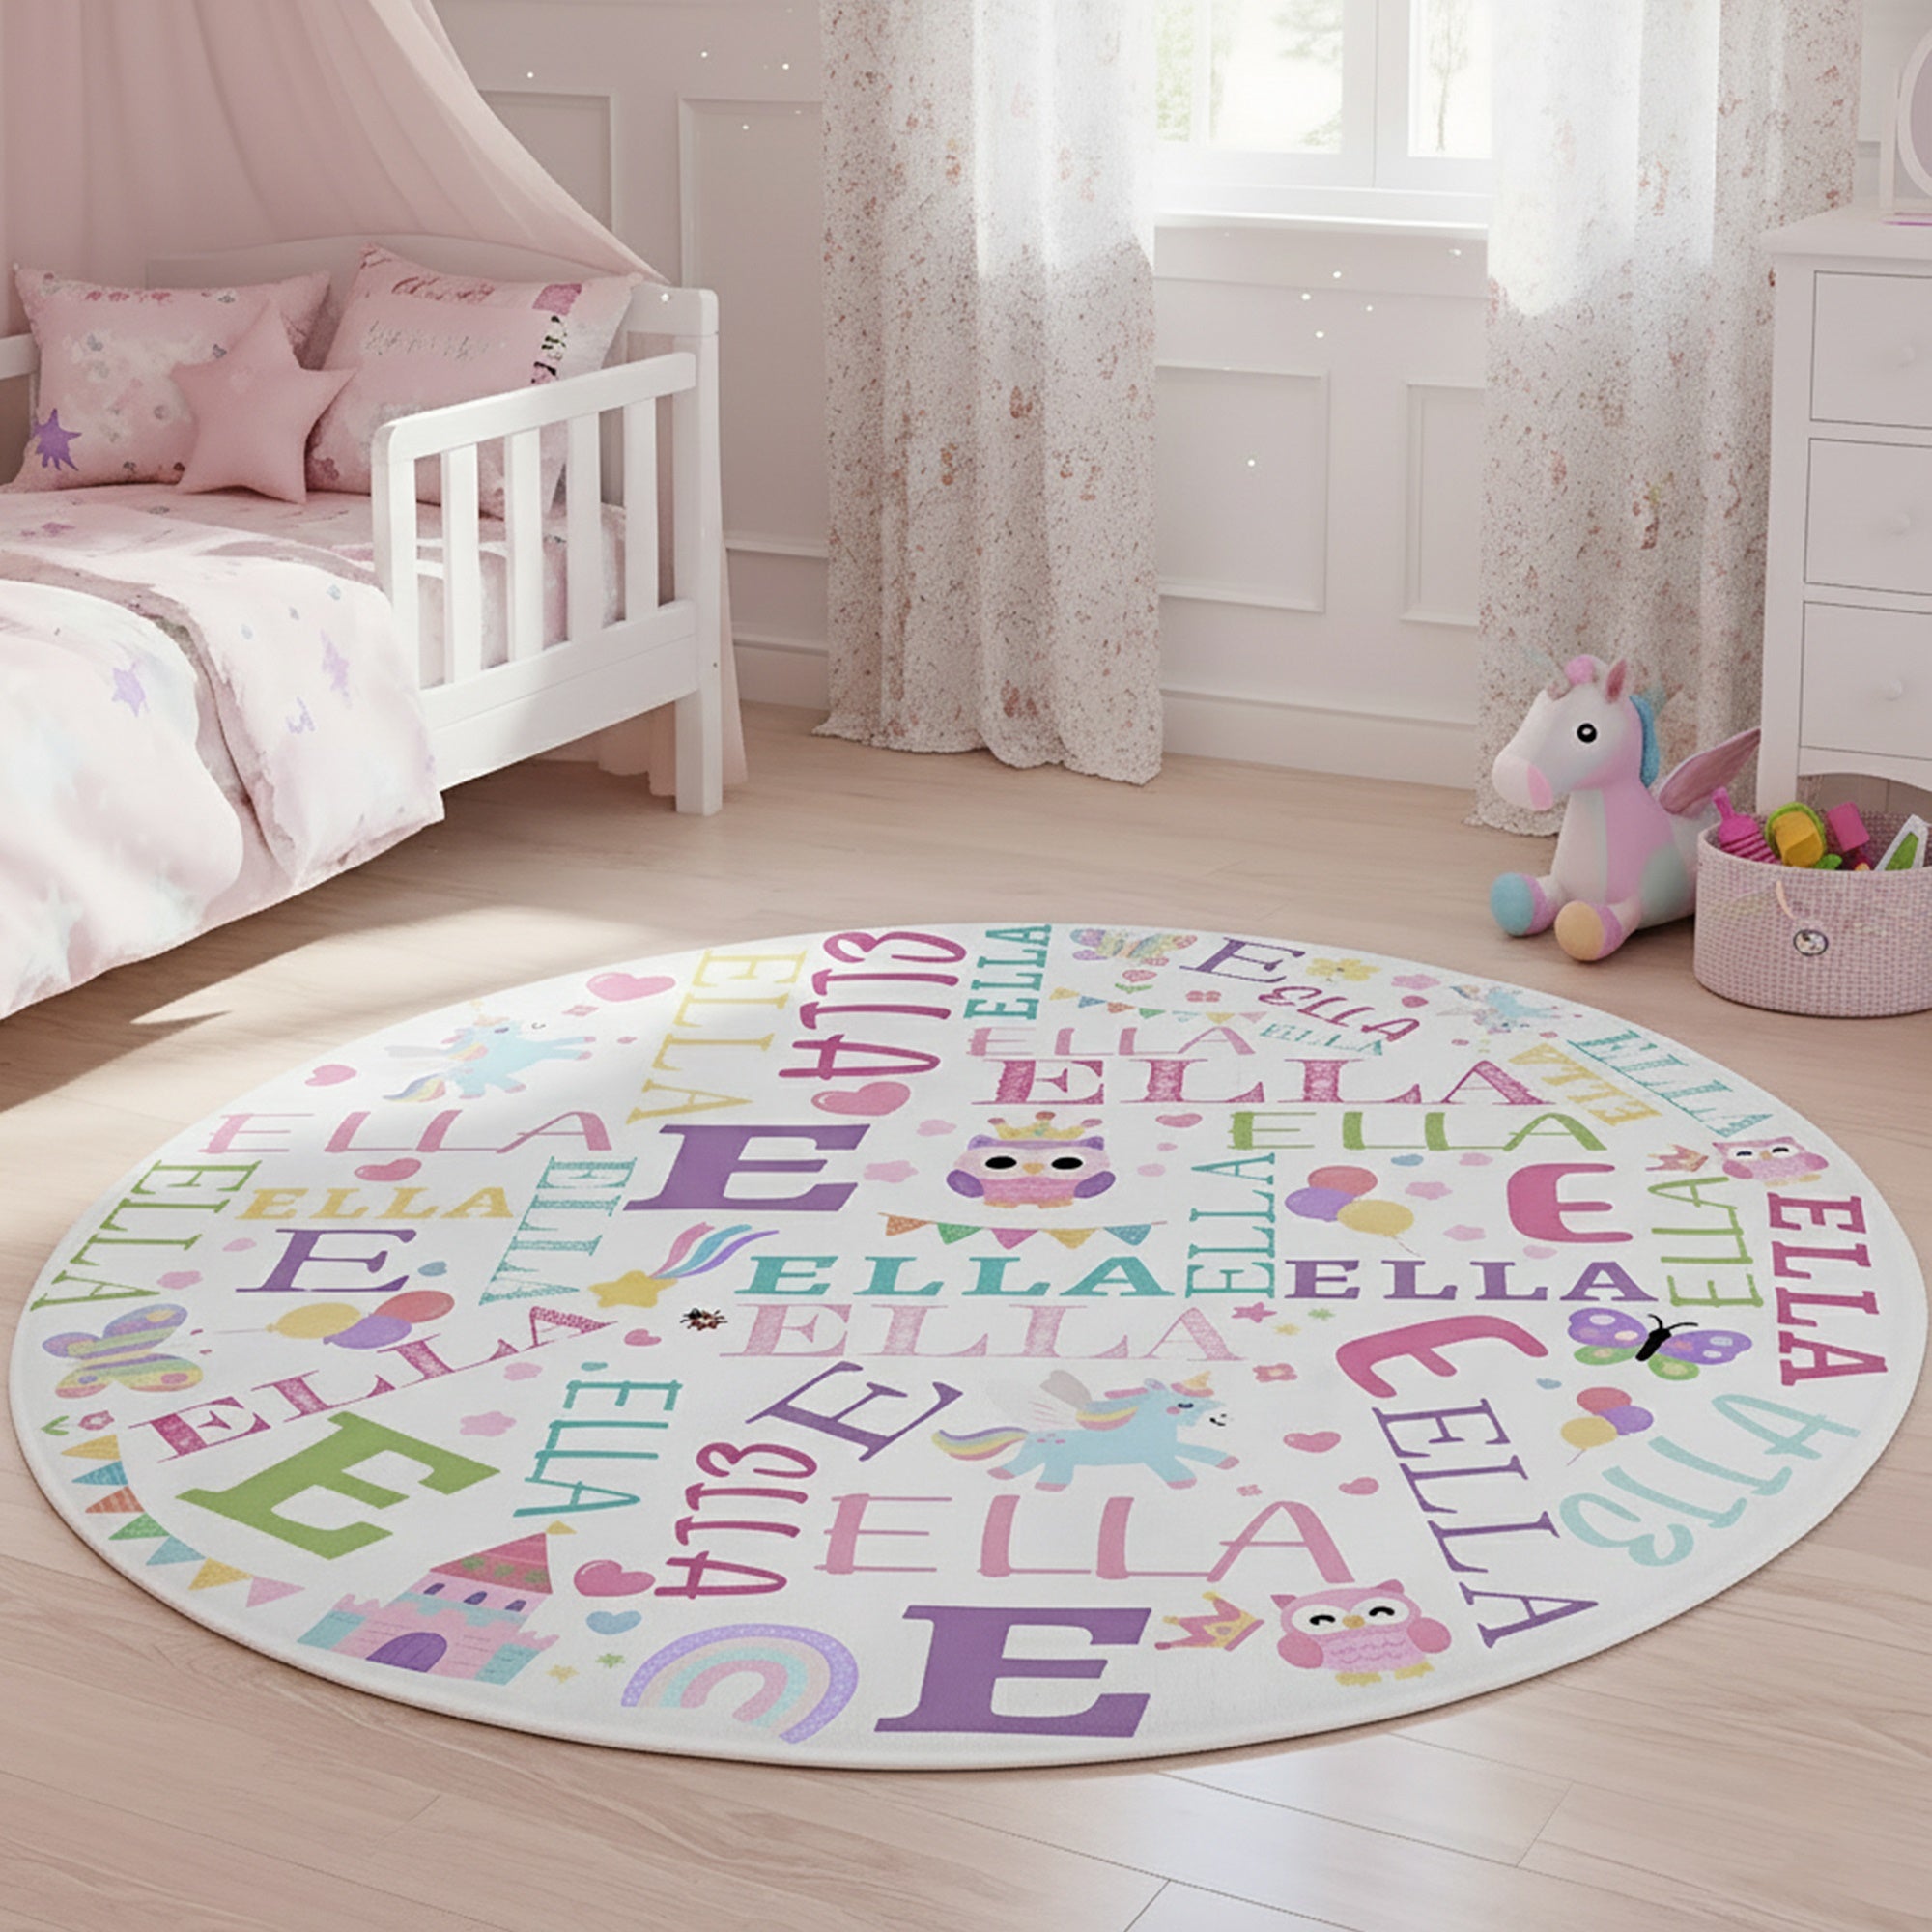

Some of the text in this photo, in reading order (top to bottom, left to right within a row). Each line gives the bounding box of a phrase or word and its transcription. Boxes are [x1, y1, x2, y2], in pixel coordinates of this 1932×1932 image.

[779, 931, 967, 1081] ELLA
[964, 924, 1052, 1020] ELLA
[1179, 937, 1305, 983] E
[626, 948, 808, 1124] ELLA
[966, 1026, 1256, 1056] ELLA
[1258, 986, 1421, 1042] ELLA
[1259, 1023, 1383, 1056] ELLA
[971, 1059, 1557, 1105] ELLA
[1508, 1042, 1662, 1127] ELLA
[1567, 1030, 1773, 1138] ELLA
[198, 1110, 612, 1153] ELLA
[623, 1124, 870, 1211] E
[1227, 1111, 1607, 1151] ELLA
[29, 1159, 262, 1311] ELLA
[234, 1187, 514, 1220] ELLA
[478, 1155, 638, 1306] ELLA
[1185, 1152, 1275, 1299] ELLA
[1506, 1163, 1633, 1243] E
[1647, 1176, 1764, 1308] ELLA
[235, 1228, 417, 1293] E
[734, 1256, 1175, 1296] ELLA
[1284, 1259, 1659, 1301] ELLA
[1766, 1192, 1888, 1385] ELLA
[719, 1303, 1249, 1362] ELLA
[1336, 1315, 1548, 1398] E
[128, 1306, 618, 1463] ELLA
[745, 1360, 963, 1462] E
[175, 1410, 500, 1559] E
[513, 1379, 683, 1518] ELLA
[1559, 1394, 1861, 1567] ELLA
[654, 1442, 817, 1599] ELLA
[814, 1493, 1354, 1583] ELLA
[1371, 1398, 1599, 1648] ELLA
[873, 1605, 1151, 1737] E
